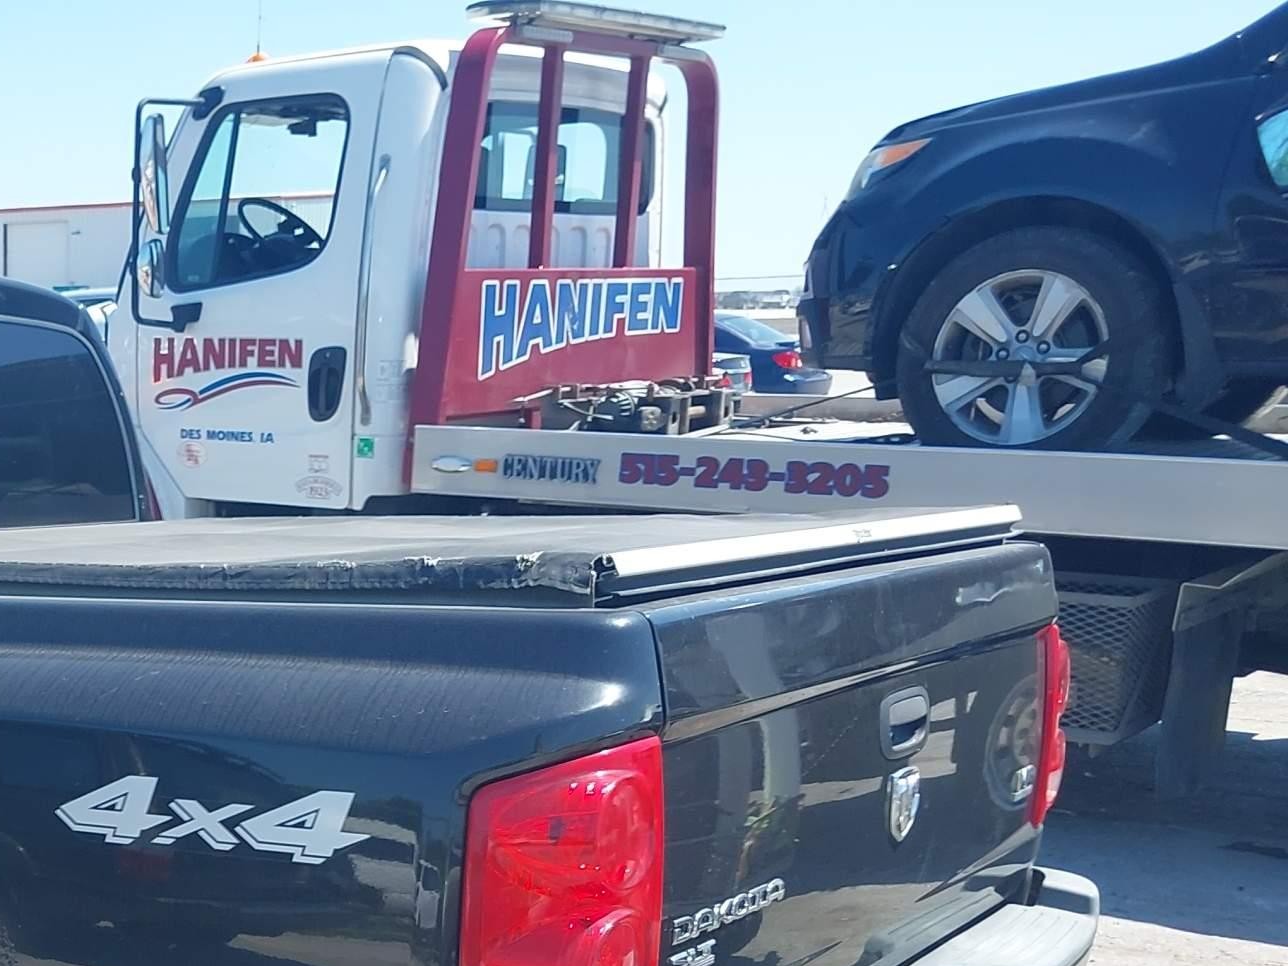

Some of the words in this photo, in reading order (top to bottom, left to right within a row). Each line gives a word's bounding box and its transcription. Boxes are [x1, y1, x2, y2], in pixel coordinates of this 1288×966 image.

[477, 277, 684, 381] HANIFEN
[153, 337, 303, 383] HANIFEN
[180, 428, 202, 440] DES
[260, 432, 274, 443] IA
[501, 453, 600, 485] CENTURY
[618, 452, 890, 500] 515-243-3205
[672, 878, 785, 946] DAKOTA
[669, 939, 717, 966] SLT
